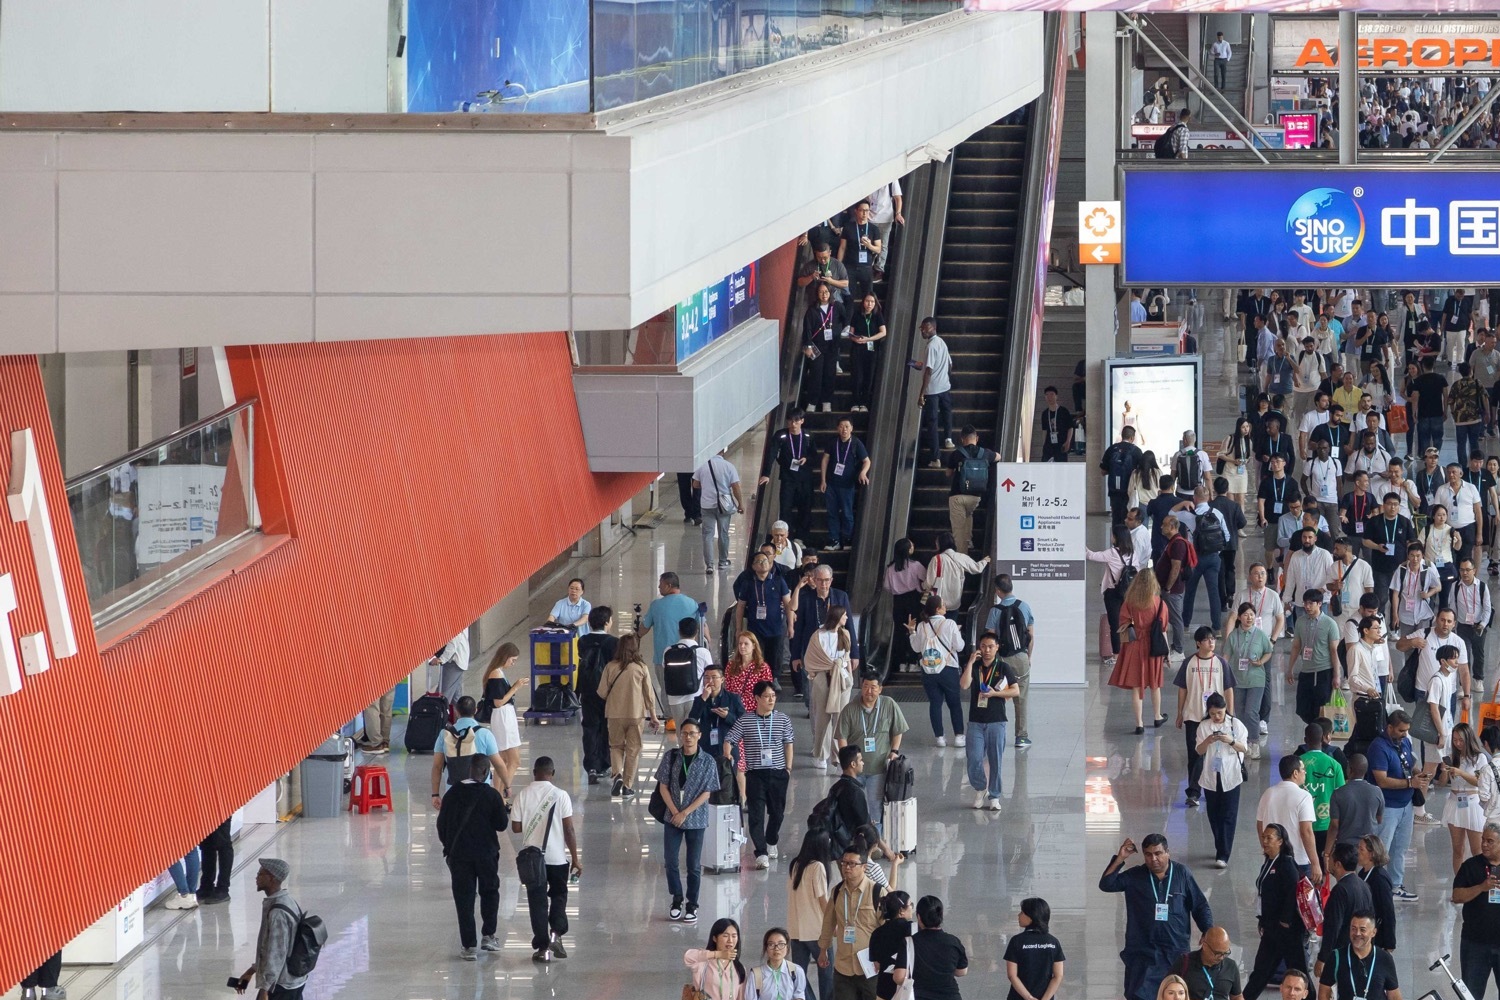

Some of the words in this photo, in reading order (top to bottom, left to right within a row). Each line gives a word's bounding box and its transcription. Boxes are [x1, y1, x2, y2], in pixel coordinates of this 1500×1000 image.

[1414, 24, 1442, 34] GLOBAL
[1295, 219, 1345, 241] SINO
[1301, 237, 1354, 254] SURE
[1021, 480, 1037, 492] 2F
[1036, 497, 1068, 507] 1.2-5.2
[1012, 564, 1028, 577] LF
